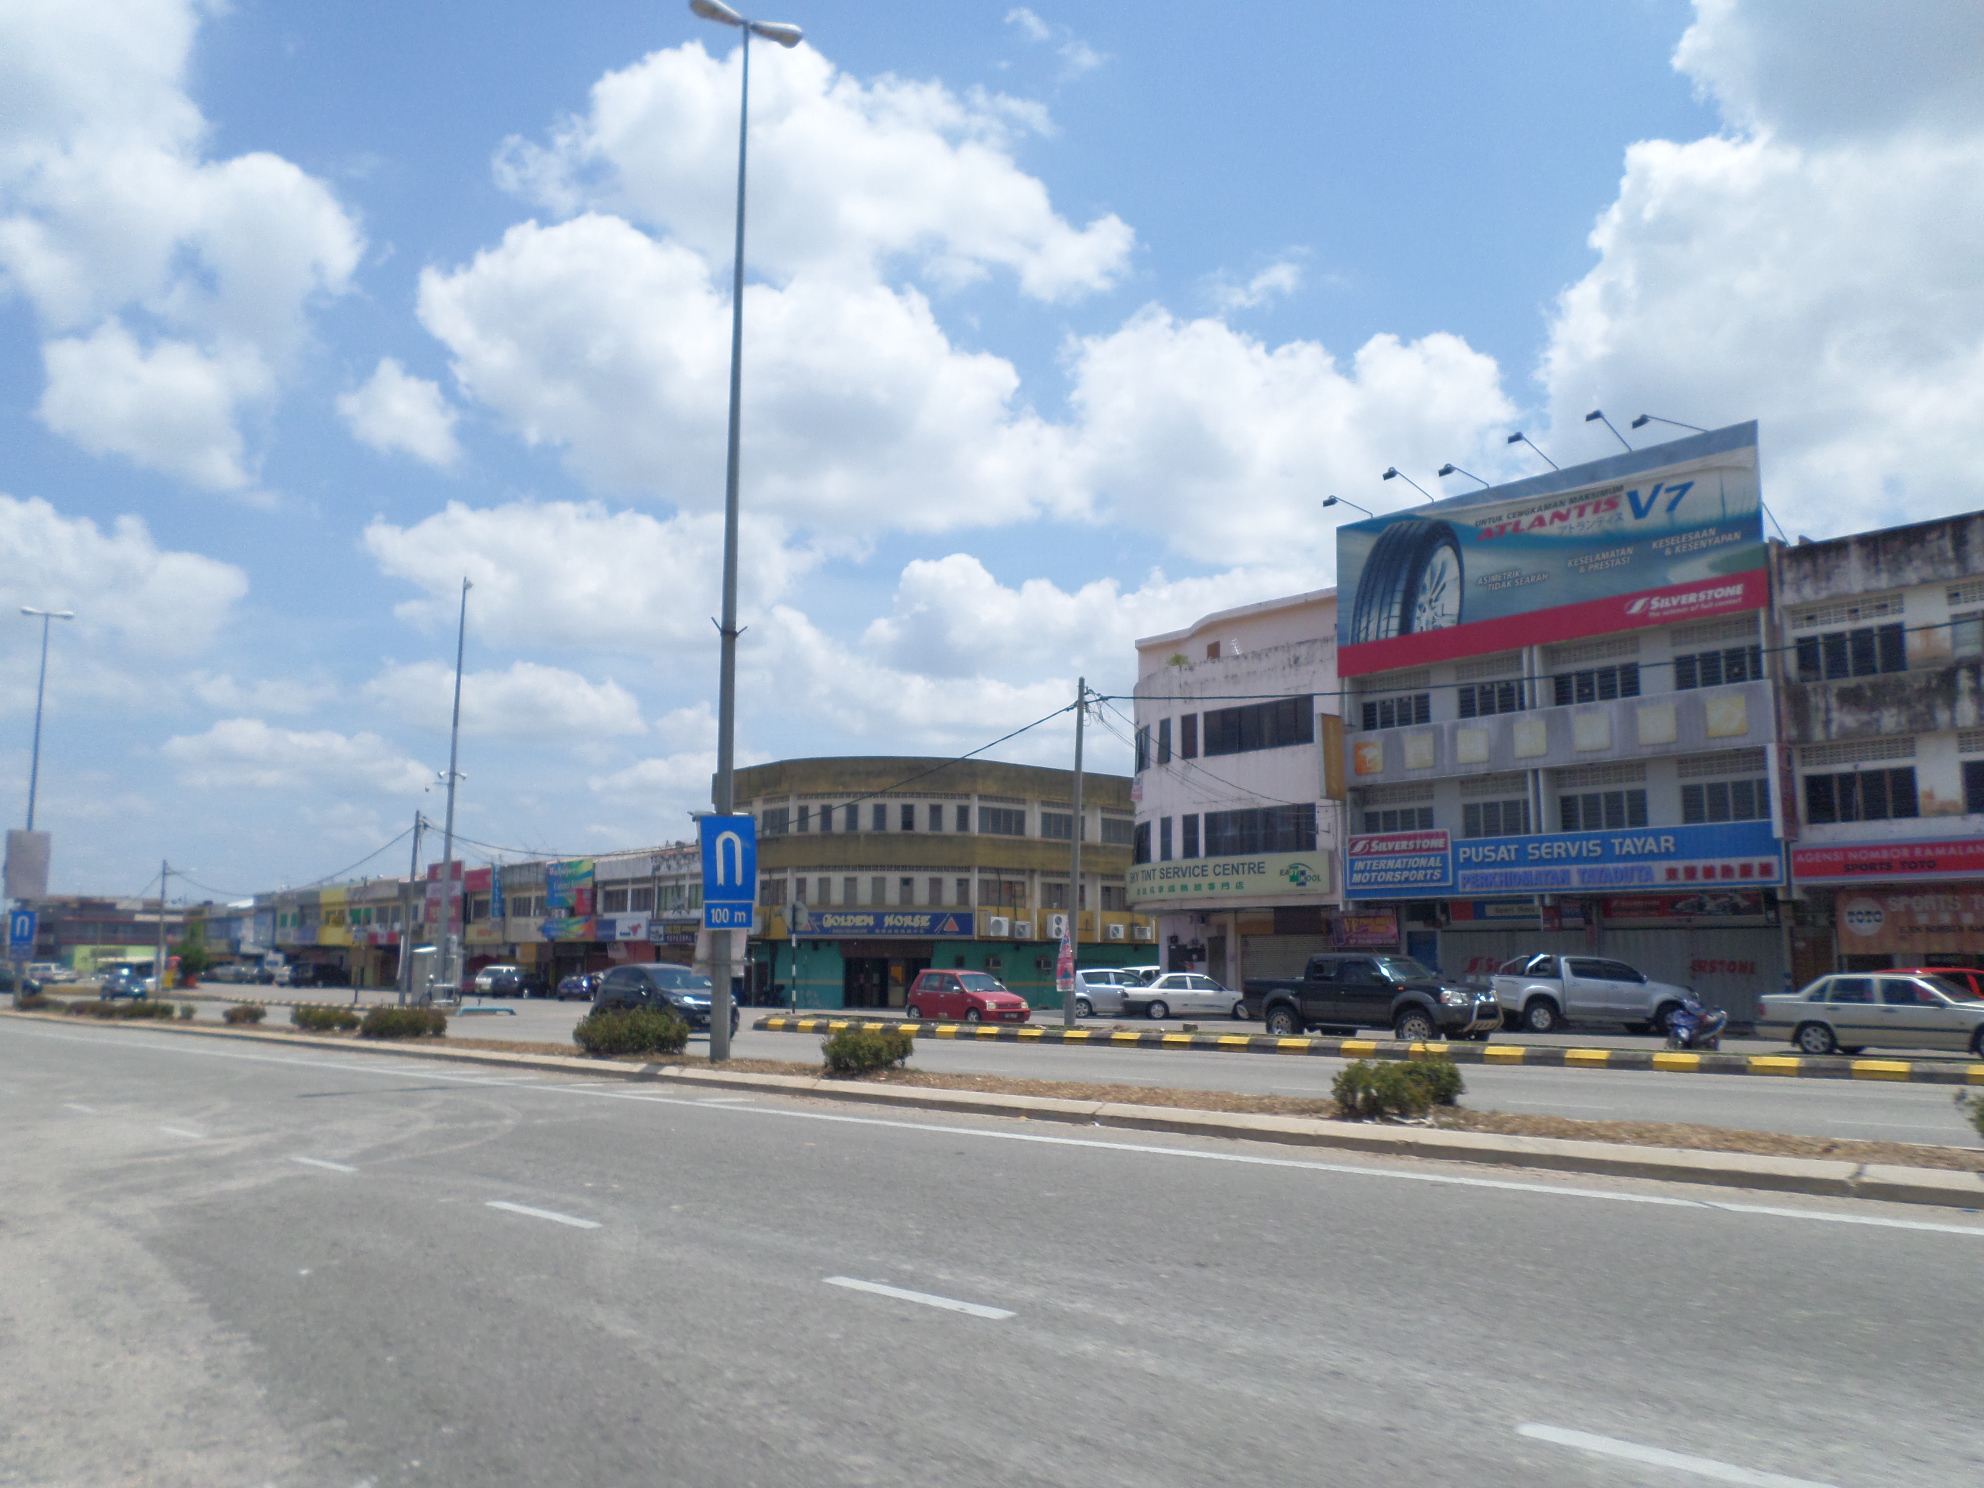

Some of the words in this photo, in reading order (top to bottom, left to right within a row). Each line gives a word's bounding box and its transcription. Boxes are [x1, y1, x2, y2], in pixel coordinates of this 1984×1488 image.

[1475, 514, 1504, 527] UNTUK
[1506, 500, 1566, 520] CENGKAMAN
[1568, 485, 1624, 505] MAKSIMUM
[1476, 494, 1623, 542] ATLANTIS
[1626, 481, 1695, 520] V7
[1652, 527, 1717, 550] KESELESAAN
[1664, 547, 1672, 556] &
[1675, 531, 1742, 553] KESENYAPAN
[1567, 546, 1634, 567] KESELAMATAN
[1588, 556, 1630, 571] PRESTASI
[1477, 570, 1521, 585] ASIMETRIK
[1487, 580, 1513, 591] TIDAK
[1515, 573, 1549, 587] SEARAH
[1459, 844, 1519, 863] PUSAT
[1528, 840, 1603, 860] SERVIS
[1611, 835, 1677, 856] TAYAR
[1796, 850, 1844, 863] AGENSI
[1848, 848, 1910, 861] NOMBOR
[1141, 868, 1157, 882] TINT
[1159, 864, 1209, 880] SERVICE
[1213, 861, 1266, 877] CENTRE
[1353, 856, 1443, 871] INTERNATIONAL
[1843, 861, 1894, 873] SPORTS
[1900, 859, 1937, 870] TOTO
[1352, 869, 1442, 883] MOTORSPORTS
[1460, 868, 1571, 889] PERKHIDMATAN
[711, 908, 730, 923] 100
[734, 911, 746, 923] m
[1847, 910, 1883, 924] TOTO
